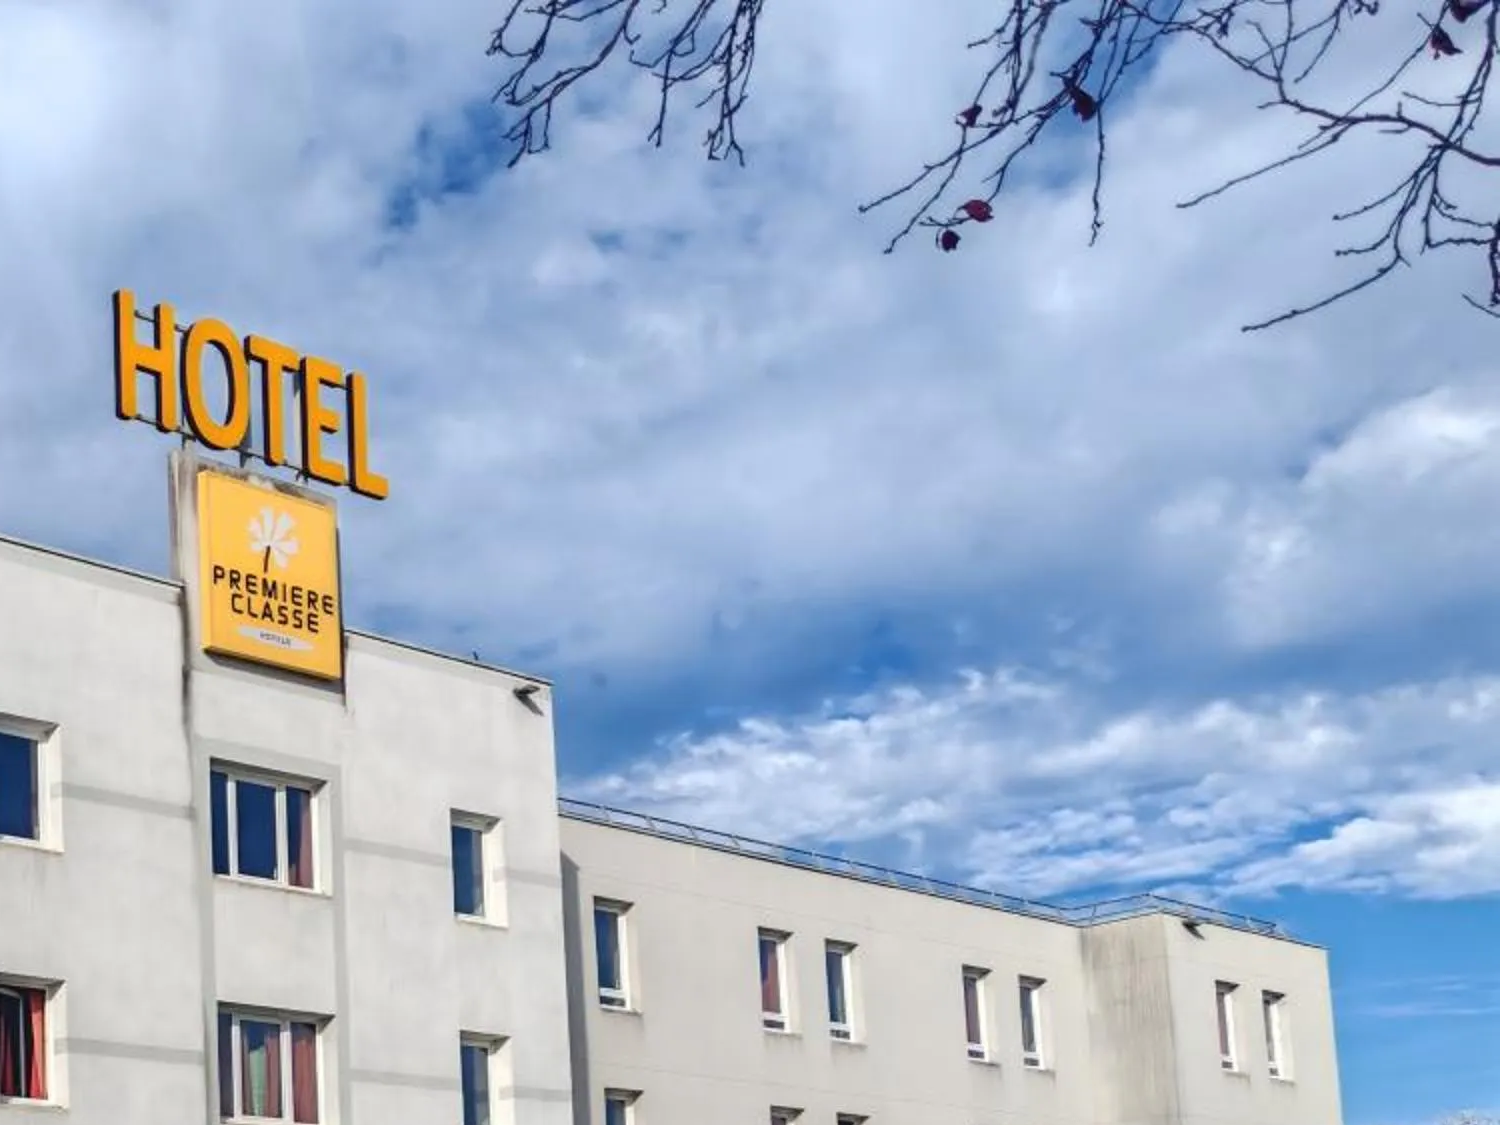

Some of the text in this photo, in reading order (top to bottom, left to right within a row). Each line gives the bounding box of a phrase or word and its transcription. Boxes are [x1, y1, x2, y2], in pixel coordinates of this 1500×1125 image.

[114, 288, 389, 499] HOTEL
[213, 565, 334, 615] PREMIERE
[231, 593, 319, 634] CLASSE
